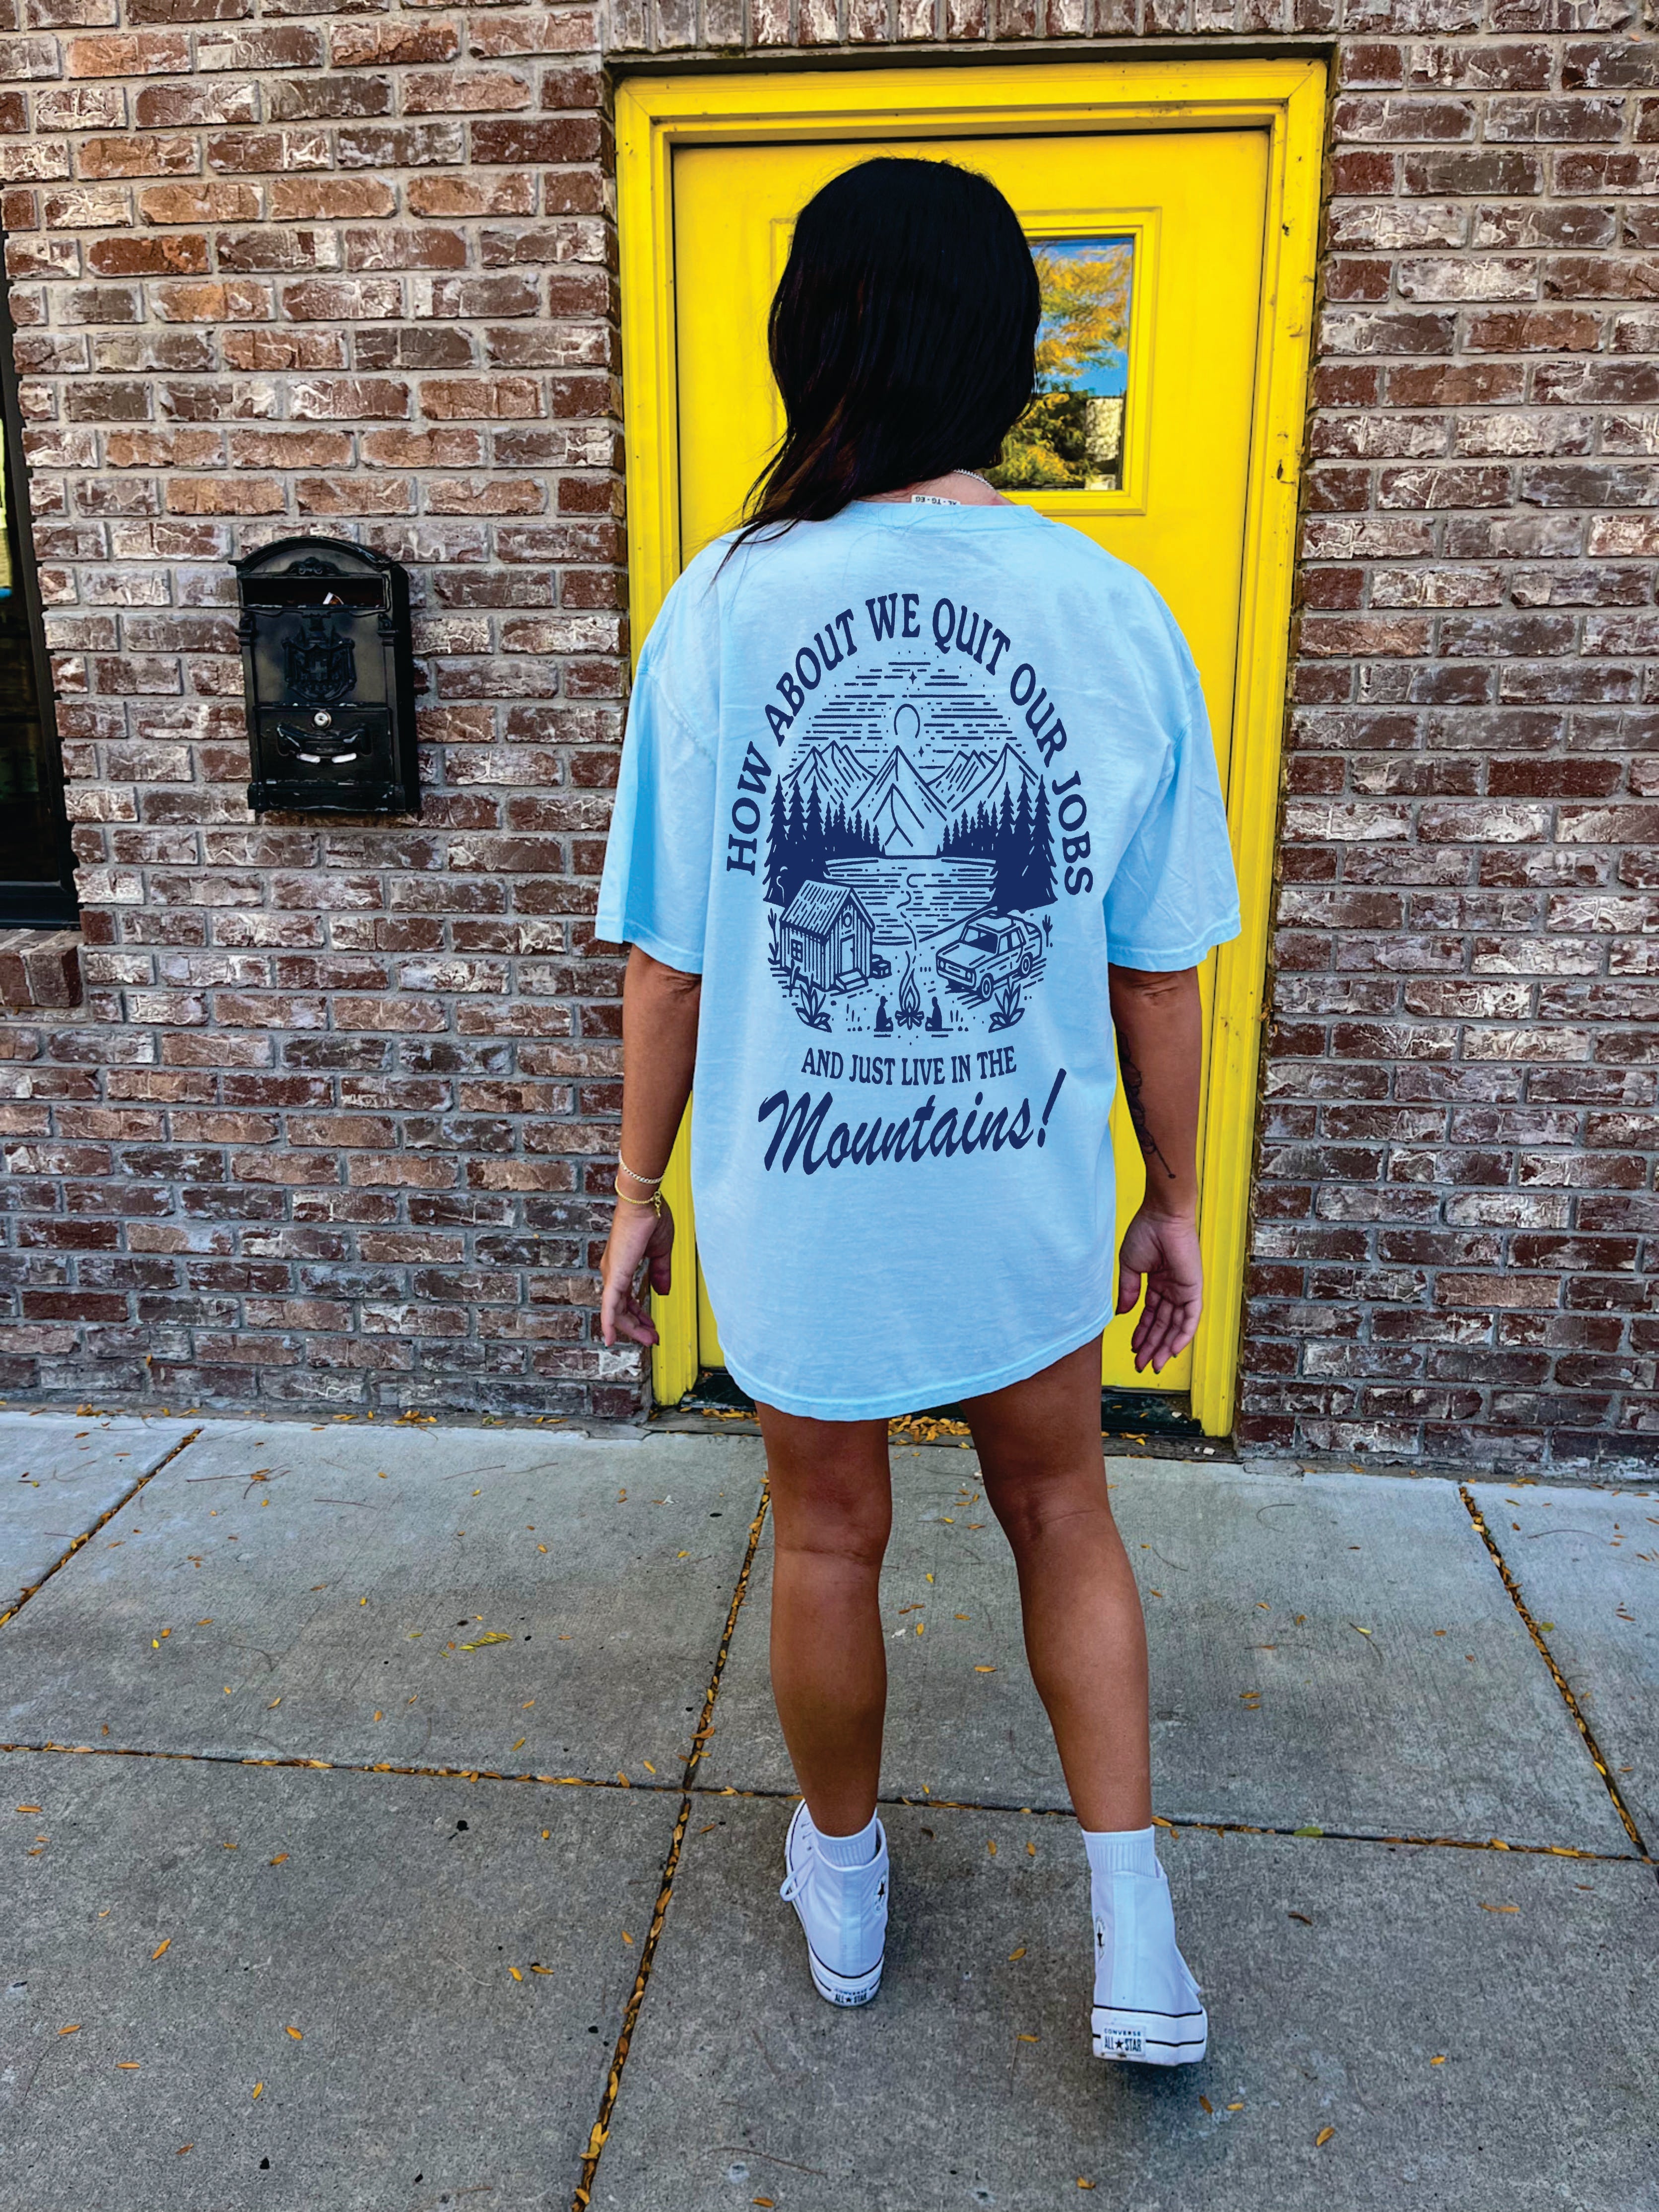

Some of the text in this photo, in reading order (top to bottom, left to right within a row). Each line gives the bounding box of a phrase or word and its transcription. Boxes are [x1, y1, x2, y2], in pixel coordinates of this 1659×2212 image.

[726, 593, 1093, 895] HOW ABOUT WE QUIT OUR JOBS
[801, 1045, 1017, 1086] AND JUST LIVE IN THE
[758, 1068, 1067, 1175] Mountains!
[1104, 2028, 1141, 2036] CONVERSE
[1105, 2036, 1141, 2051] ALL STAR
